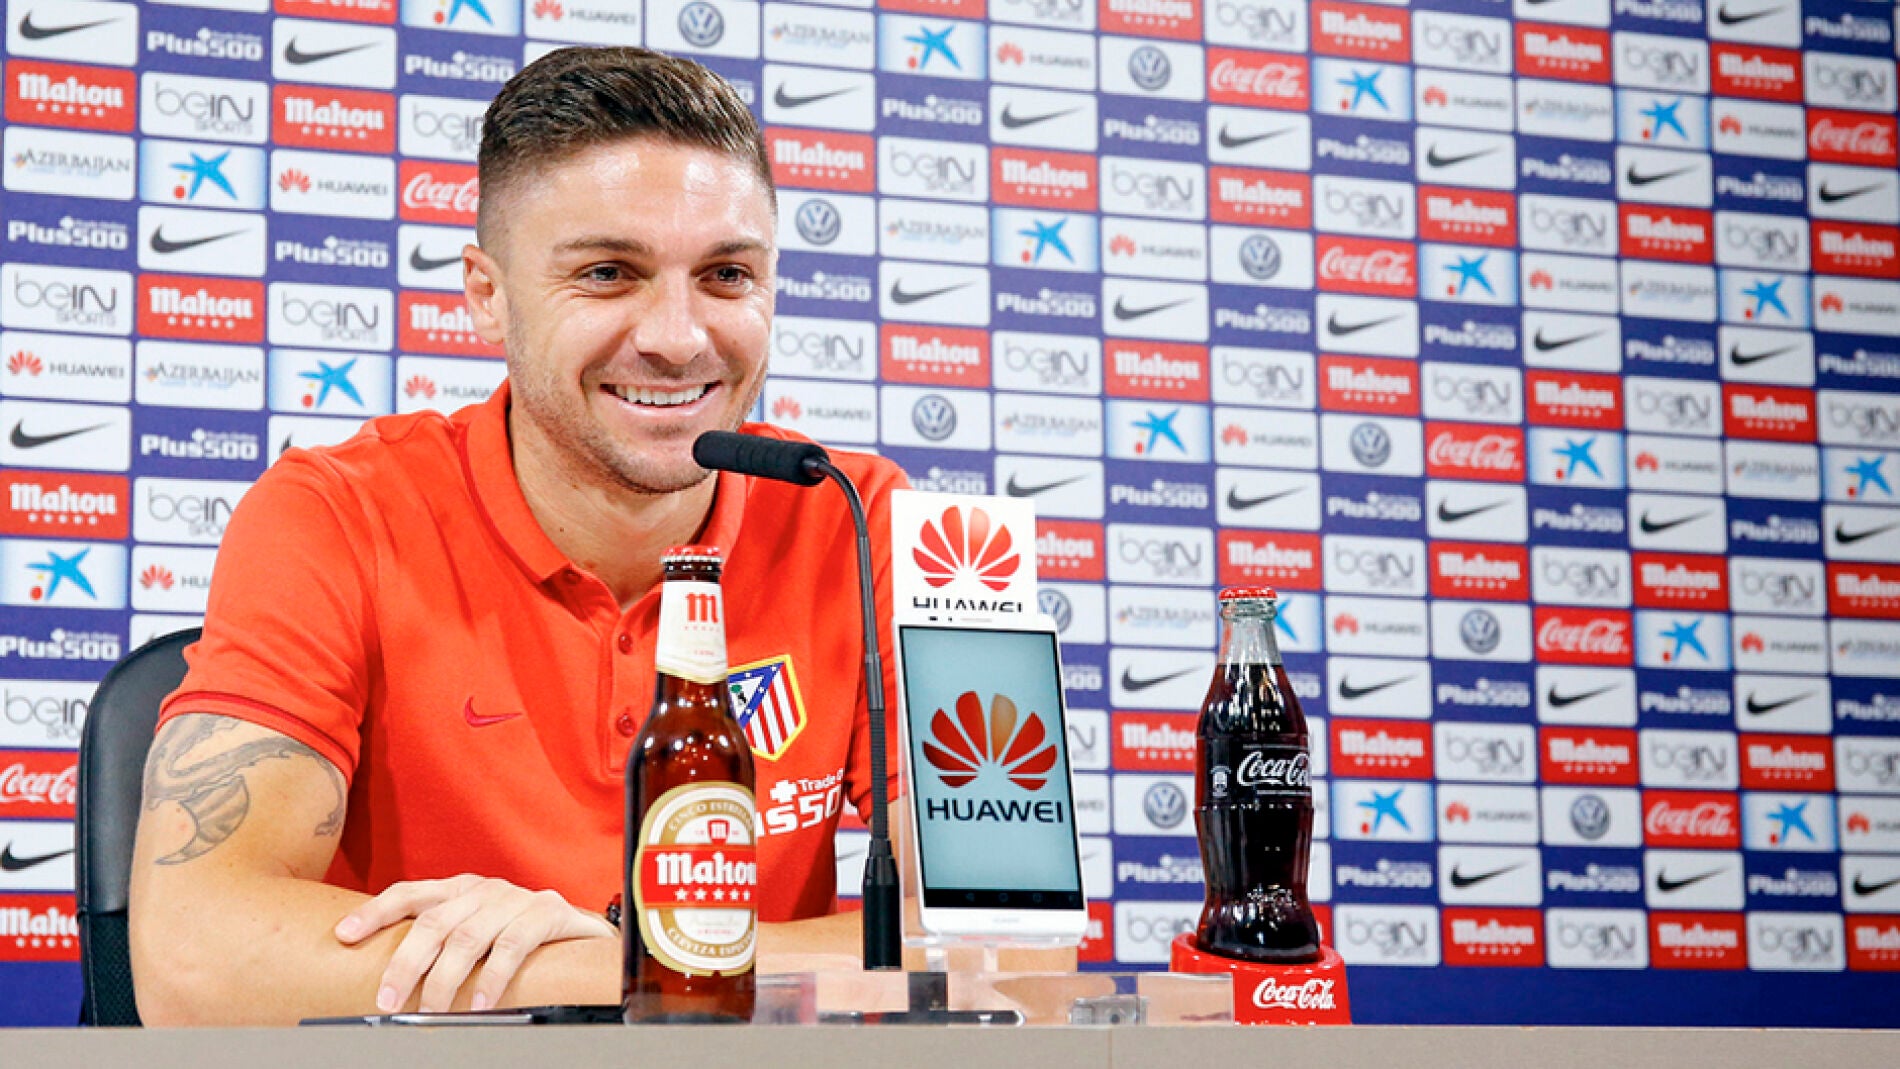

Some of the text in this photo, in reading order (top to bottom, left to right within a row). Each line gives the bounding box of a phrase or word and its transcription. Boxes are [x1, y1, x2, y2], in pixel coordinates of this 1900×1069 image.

[569, 9, 636, 25] HUAWEI
[1320, 11, 1401, 40] Mahou
[147, 31, 262, 60] Plus500
[1524, 33, 1603, 61] Mahou
[18, 73, 124, 107] Mahou
[1212, 60, 1304, 97] Coca-Cola
[155, 83, 253, 120] beIN
[284, 97, 384, 129] Mahou
[883, 100, 982, 124] Plus500
[195, 120, 253, 135] SPORTS
[1105, 121, 1199, 145] Plus500
[1810, 120, 1895, 155] Coca-Cola
[21, 150, 129, 172] AZERBAIJAN
[774, 140, 864, 169] Mahou
[890, 147, 974, 182] beIN
[1002, 159, 1087, 188] Mahou
[1112, 167, 1193, 199] beIN
[317, 180, 388, 196] HUAWEI
[1219, 179, 1302, 206] Mahou
[1427, 198, 1508, 225] Mahou
[8, 220, 128, 249] Plus500
[275, 241, 388, 267] Plus500
[1320, 248, 1412, 284] Coca-Cola
[14, 272, 116, 311] beIN
[150, 288, 254, 317] Mahou
[997, 292, 1094, 318] Plus500
[56, 311, 116, 327] SPORTS
[282, 292, 378, 328] beIN
[322, 327, 378, 343] SPORTS
[891, 336, 979, 364] Mahou
[1005, 341, 1088, 373] beIN
[50, 363, 124, 379] HUAWEI
[154, 363, 259, 383] AZERBAIJAN
[1115, 351, 1199, 380] Mahou
[1329, 366, 1409, 393] Mahou
[1536, 381, 1614, 408] Mahou
[141, 437, 258, 460] Plus500
[1430, 433, 1519, 469] Coca-Cola
[910, 474, 986, 494] us500
[10, 483, 117, 515] Mahou
[1111, 488, 1207, 509] Plus500
[1036, 529, 1094, 557] ahou
[1119, 534, 1200, 566] beIN
[1228, 542, 1311, 567] Mahou
[1438, 552, 1519, 579] Mahou
[685, 592, 718, 623] m
[1540, 617, 1628, 655] Coca-Cola
[1341, 730, 1423, 757] Mahou
[1550, 738, 1629, 764] Mahou
[927, 798, 1064, 823] HUAWEI
[1647, 802, 1735, 835] Coca-Cola
[1453, 919, 1534, 945] Mahou
[1253, 977, 1336, 1009] Coca-Cola
